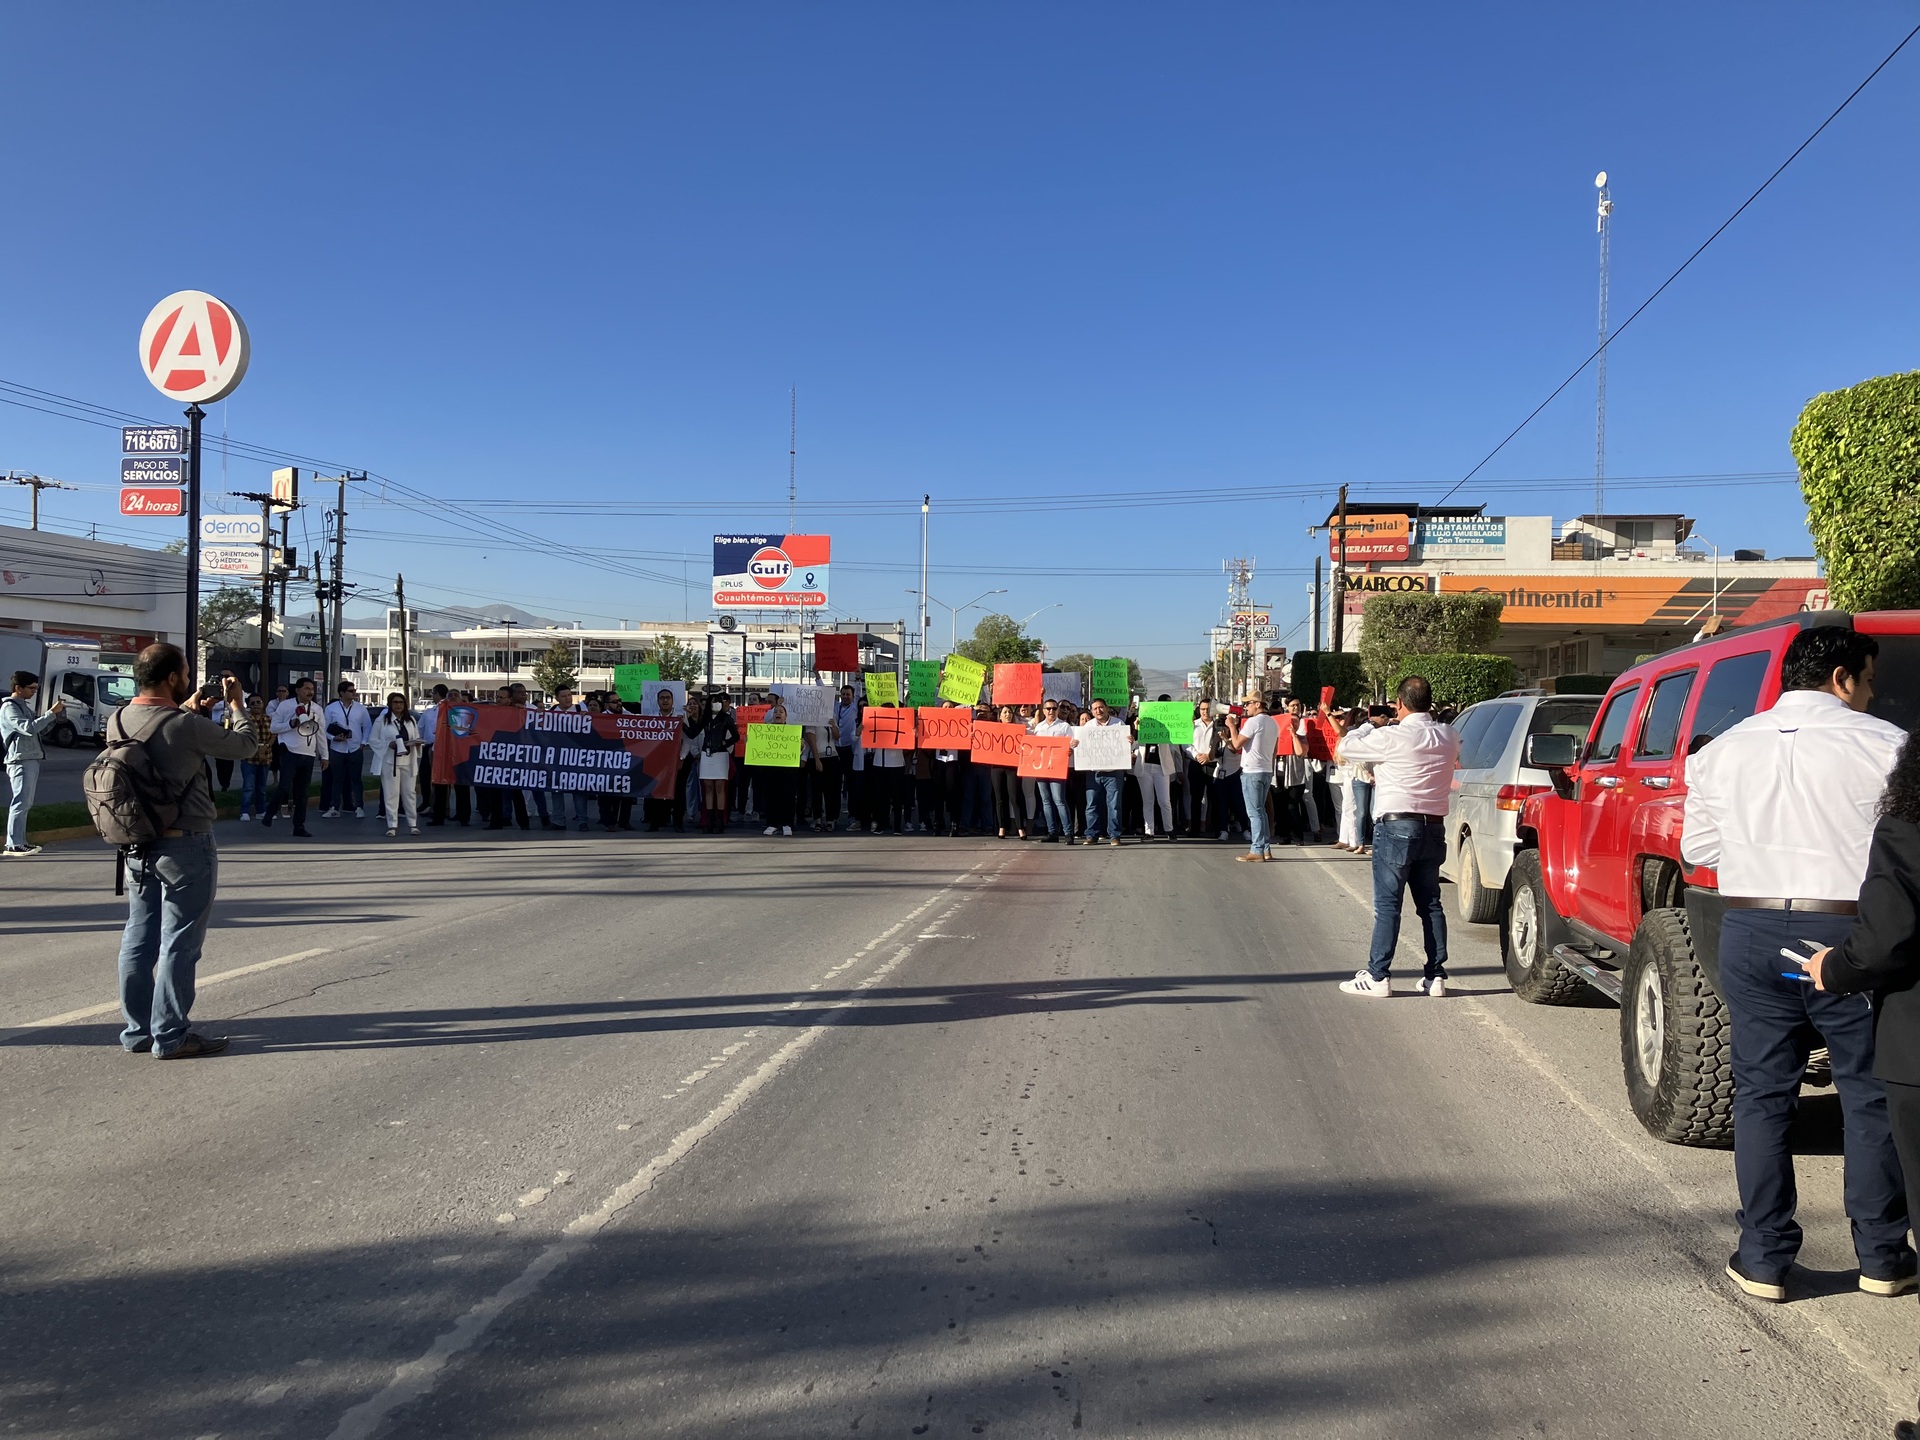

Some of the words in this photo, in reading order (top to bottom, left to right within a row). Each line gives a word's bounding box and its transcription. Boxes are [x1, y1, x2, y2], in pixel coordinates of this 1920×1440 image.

[125, 434, 177, 450] 718-6870
[133, 461, 157, 470] PAGO
[158, 461, 169, 469] DE
[123, 470, 179, 481] SERVICIOS
[126, 495, 145, 511] 24
[145, 500, 179, 511] horas
[204, 519, 260, 534] derma
[714, 536, 728, 545] Elige
[732, 536, 749, 544] bien,
[750, 537, 767, 545] elige
[750, 562, 790, 575] Gulf
[1345, 575, 1425, 592] MARCOS
[716, 593, 776, 602] Cuauhtémoc
[778, 595, 784, 604] y
[67, 656, 79, 664] 533
[618, 668, 650, 676] RESPETO
[796, 687, 823, 699] RESPETO
[941, 684, 977, 703] DERECHOS
[524, 711, 593, 734] PEDIMOS
[616, 717, 666, 729] SECCIÓN
[668, 720, 680, 730] 17
[749, 724, 763, 733] NO
[766, 724, 785, 733] SON
[868, 710, 906, 745] #
[918, 718, 970, 739] TODOS
[1140, 721, 1156, 729] SON
[619, 729, 675, 741] TORREÓN
[1088, 729, 1120, 740] RESPETO
[1140, 731, 1189, 740] LABORALES
[766, 741, 788, 750] SON
[478, 741, 542, 766] RESPETO
[545, 746, 555, 764] A
[558, 747, 632, 770] NUESTROS
[473, 764, 547, 790] DERECHOS
[551, 771, 632, 794] LABORALES
